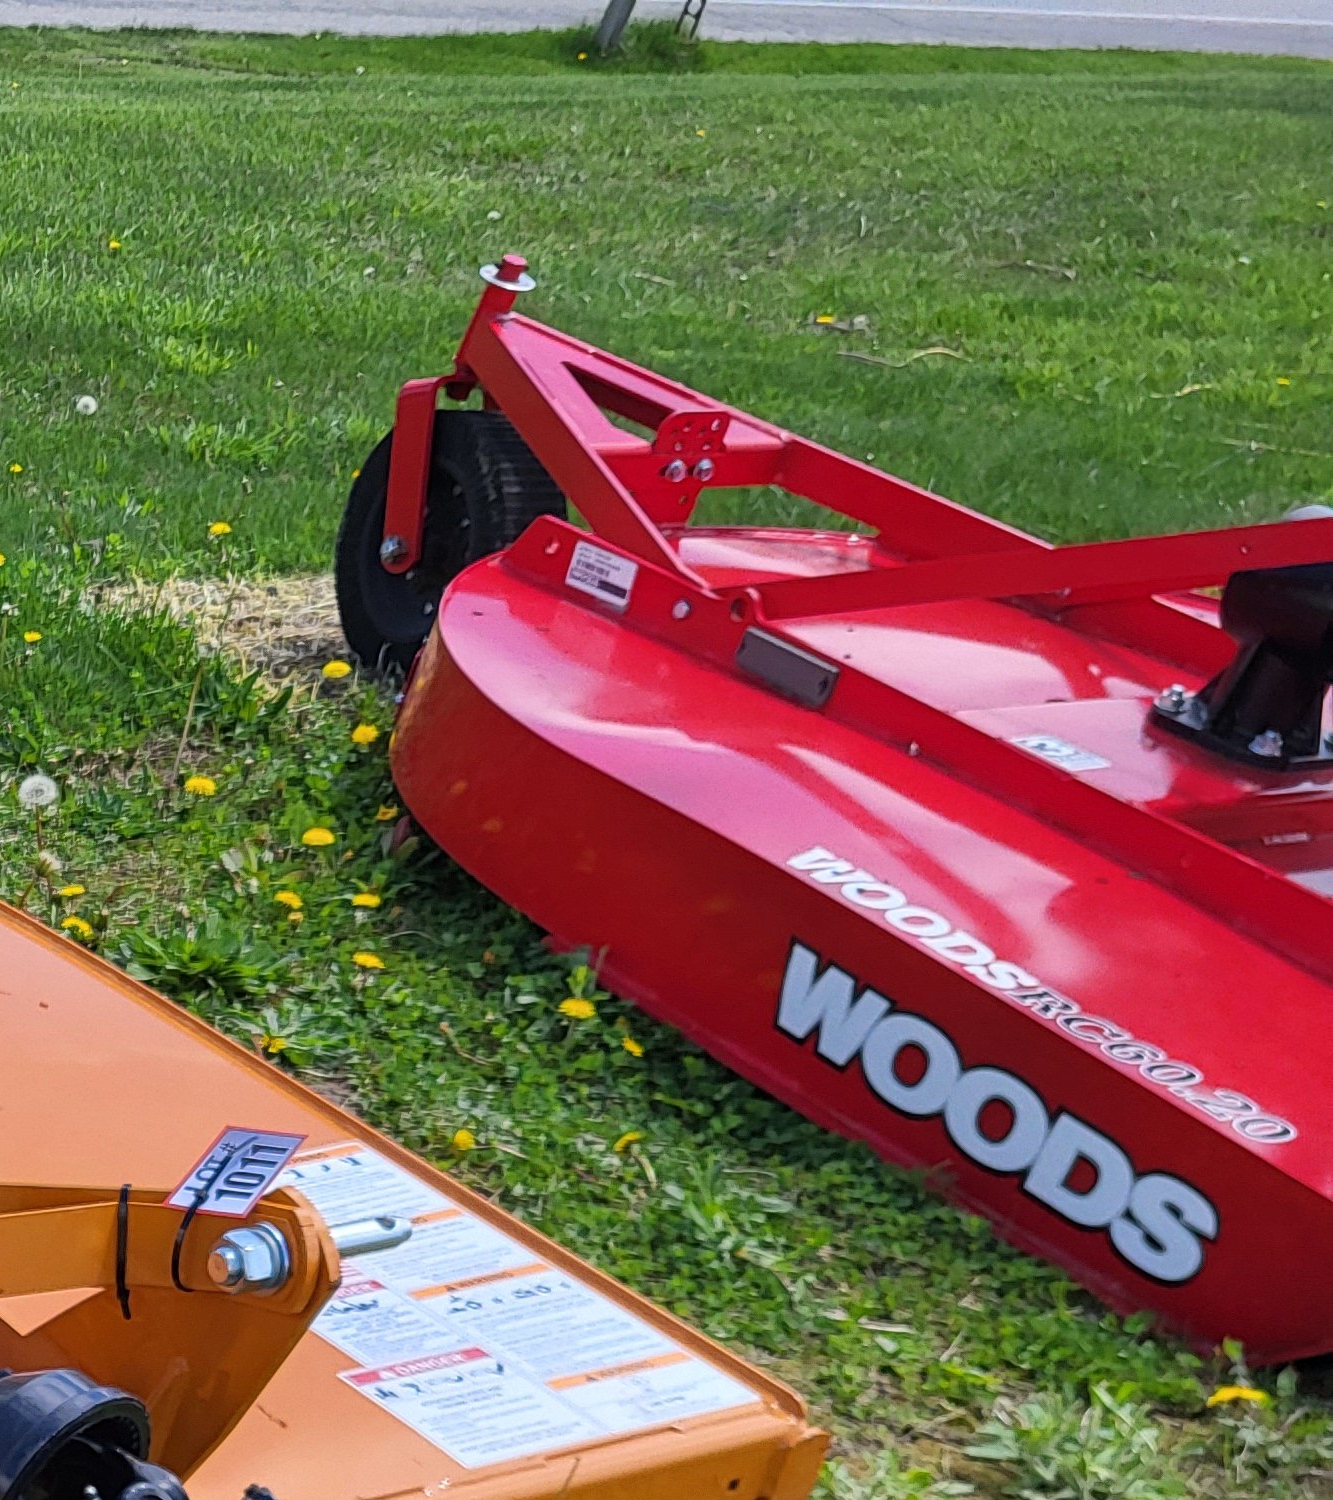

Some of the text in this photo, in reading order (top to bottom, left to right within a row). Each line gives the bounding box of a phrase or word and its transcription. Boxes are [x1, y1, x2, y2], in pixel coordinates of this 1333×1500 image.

[776, 939, 1219, 1286] WOODS
[214, 1143, 291, 1202] 1011
[395, 1351, 465, 1376] DANGER
